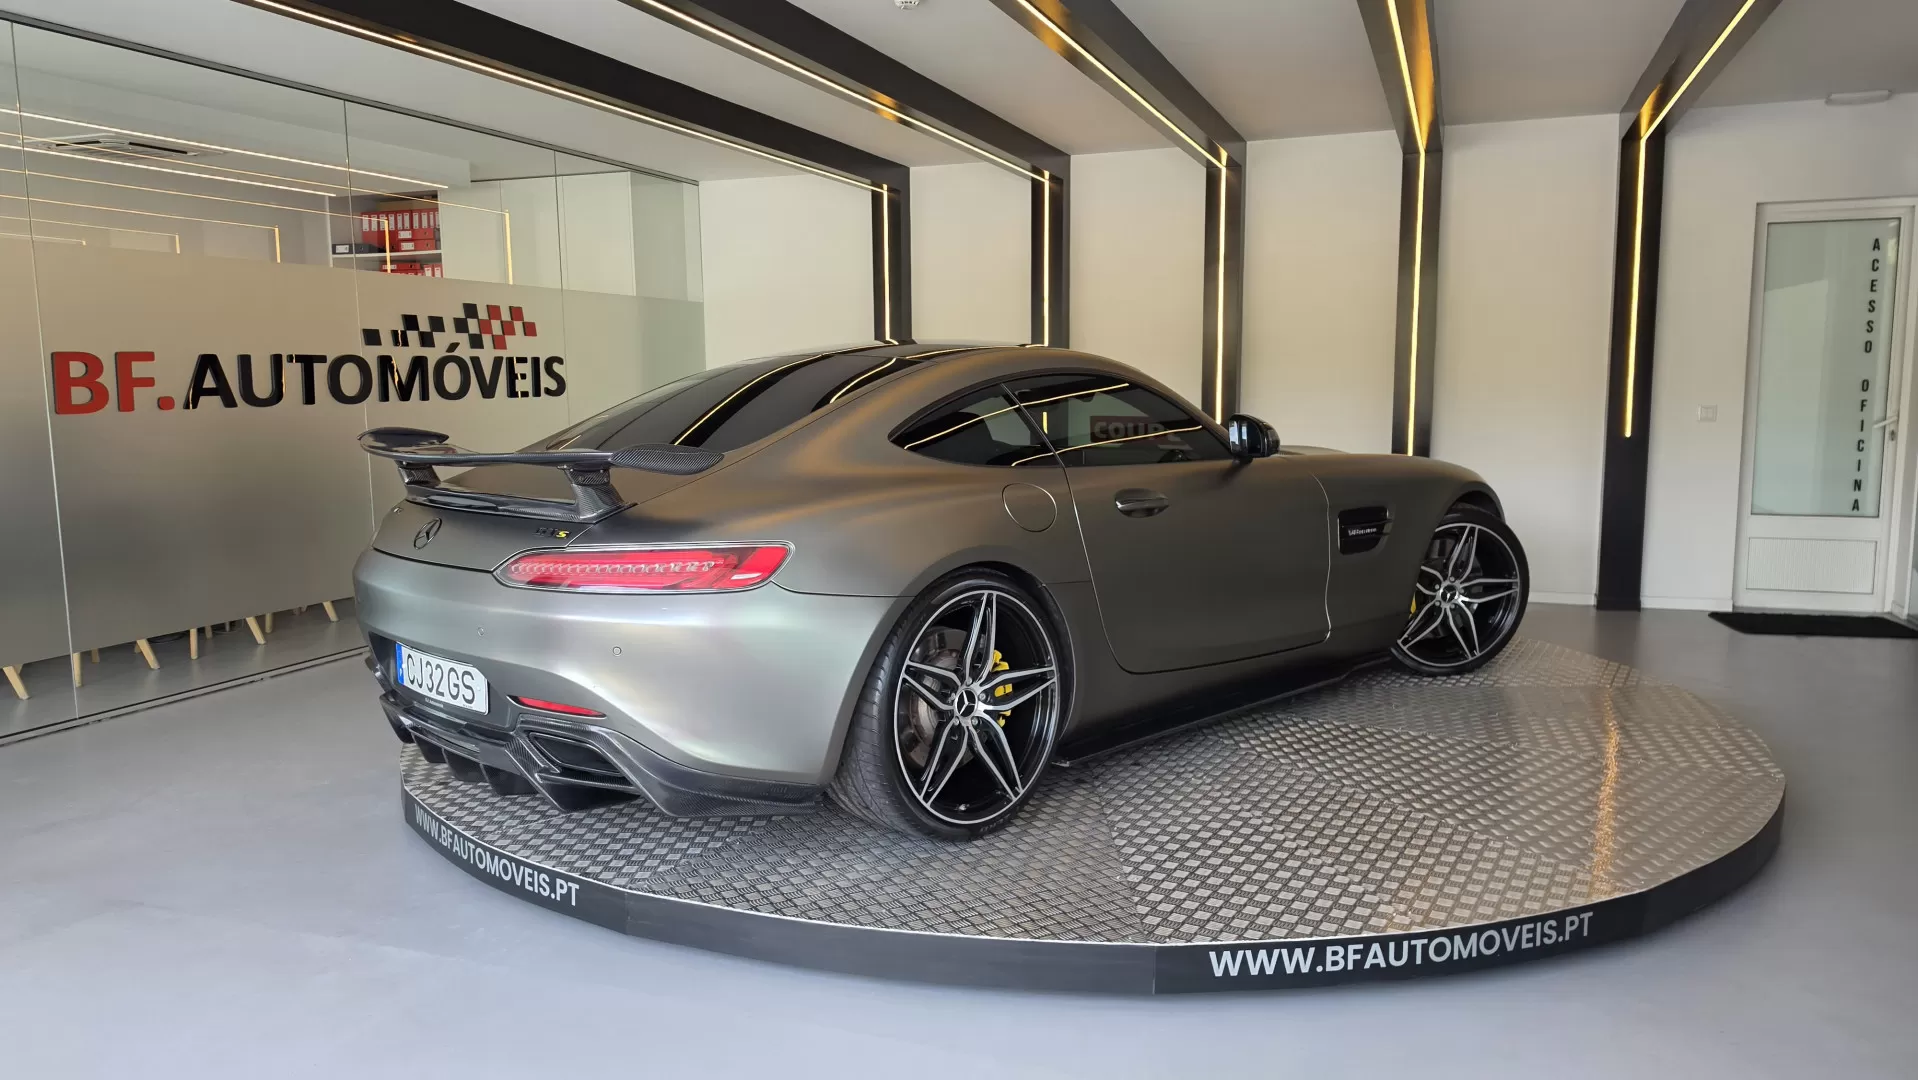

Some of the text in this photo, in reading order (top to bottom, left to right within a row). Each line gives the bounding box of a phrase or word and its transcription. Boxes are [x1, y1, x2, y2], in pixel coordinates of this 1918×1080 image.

[1852, 237, 1881, 511] ACESSO OFICINA
[1094, 421, 1182, 442] COUP
[406, 653, 475, 705] CJ32GS
[414, 803, 580, 906] WWW.BFAUTOMOVEIS.PT
[1209, 912, 1593, 977] WWW.BFAUTOMOVEIS.PT
